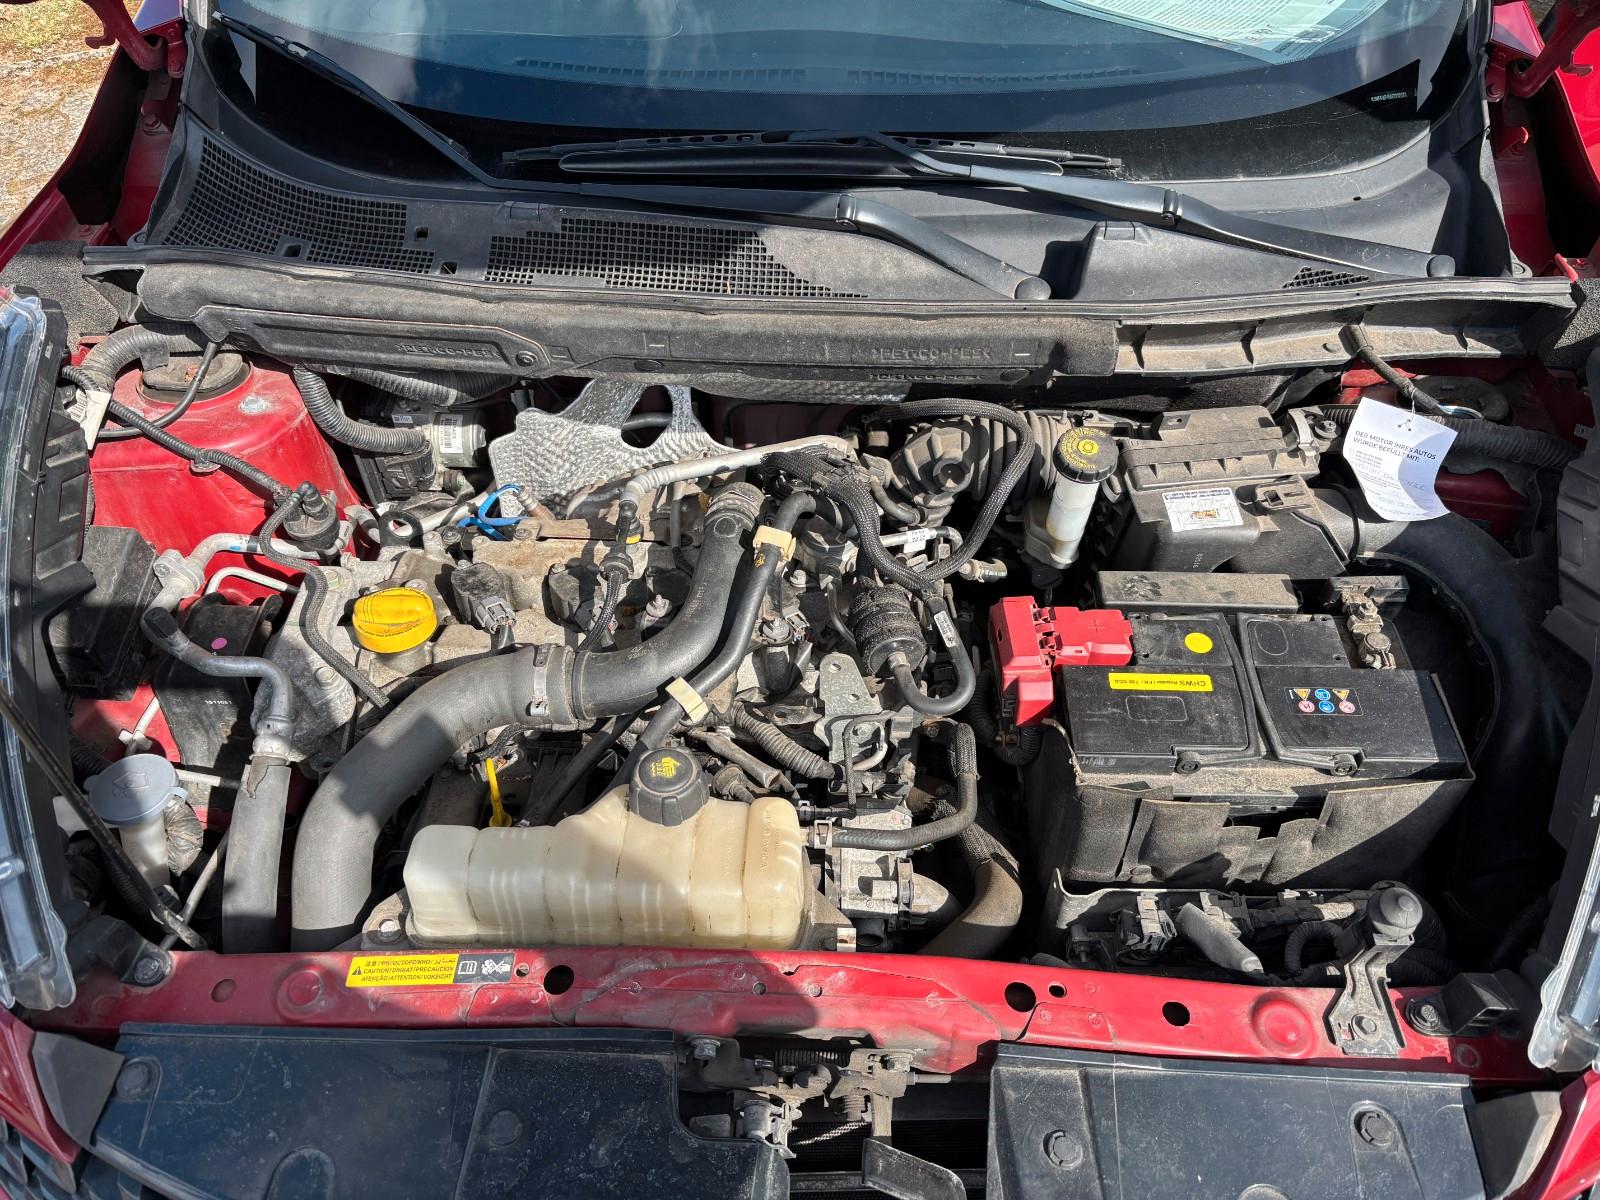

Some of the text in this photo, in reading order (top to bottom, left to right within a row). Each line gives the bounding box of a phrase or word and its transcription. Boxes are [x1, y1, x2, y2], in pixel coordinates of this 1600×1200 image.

[1353, 437, 1377, 449] WURDE
[1406, 453, 1420, 463] MIT:
[1355, 430, 1436, 460] DER MOTOR IHRES AUTOS
